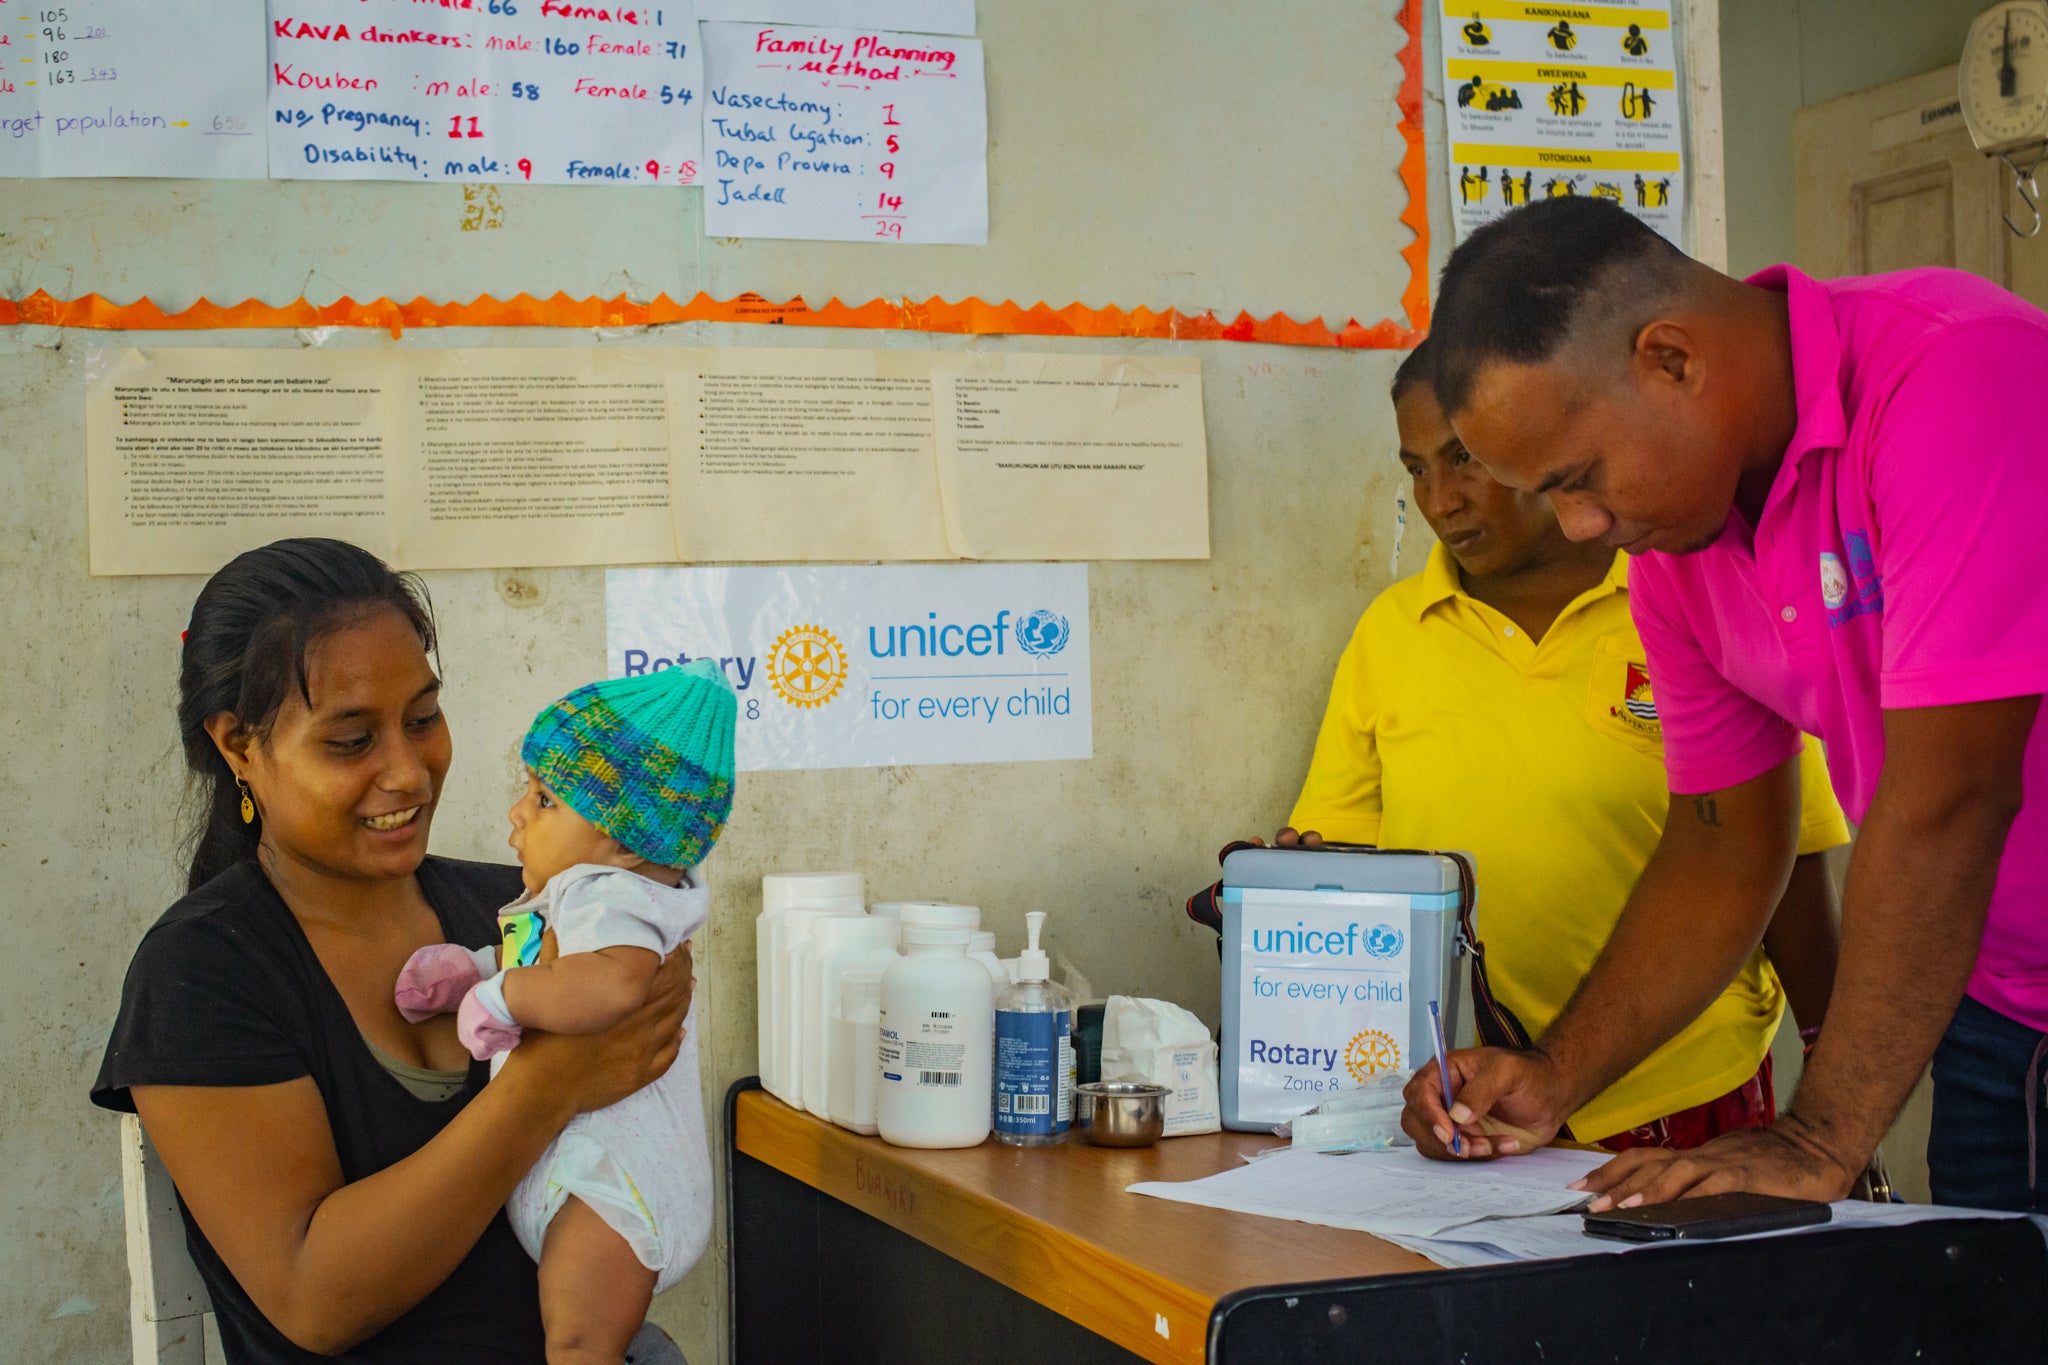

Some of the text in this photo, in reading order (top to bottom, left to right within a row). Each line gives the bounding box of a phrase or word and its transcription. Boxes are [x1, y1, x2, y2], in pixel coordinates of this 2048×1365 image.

[40, 8, 69, 23] 105
[1525, 7, 1591, 20] KANIKINAEANA
[42, 26, 107, 42] 96 201
[273, 17, 352, 42] KAVA
[544, 37, 580, 56] 160
[666, 41, 687, 60] 71
[44, 51, 69, 64] 180
[756, 30, 957, 71] Family Planning
[48, 67, 118, 86] 163 343
[273, 63, 379, 91] Kouben
[512, 81, 541, 101] 58
[660, 85, 693, 106] 54
[1537, 69, 1587, 79] EWEEWENA
[711, 86, 843, 125] Vasectomy:
[0, 110, 44, 139] rget
[56, 107, 167, 136] population
[321, 103, 431, 138] Pregnancy:
[447, 115, 484, 139] 11
[711, 118, 776, 143] Tubal
[886, 134, 900, 153] 5
[517, 158, 533, 181] 9
[716, 150, 765, 175] Depo
[879, 162, 895, 179] 9
[1538, 153, 1592, 164] TOTOKOANA
[878, 192, 904, 212] 14
[875, 220, 902, 240] 29
[286, 377, 313, 385] babaire
[869, 609, 1010, 659] unicef
[746, 698, 760, 720] 8
[870, 686, 1071, 724] for every child
[1253, 921, 1359, 956] unicef
[1253, 975, 1403, 1005] for every child
[1249, 1039, 1338, 1072] Rotary
[1283, 1075, 1340, 1092] Zone 8
